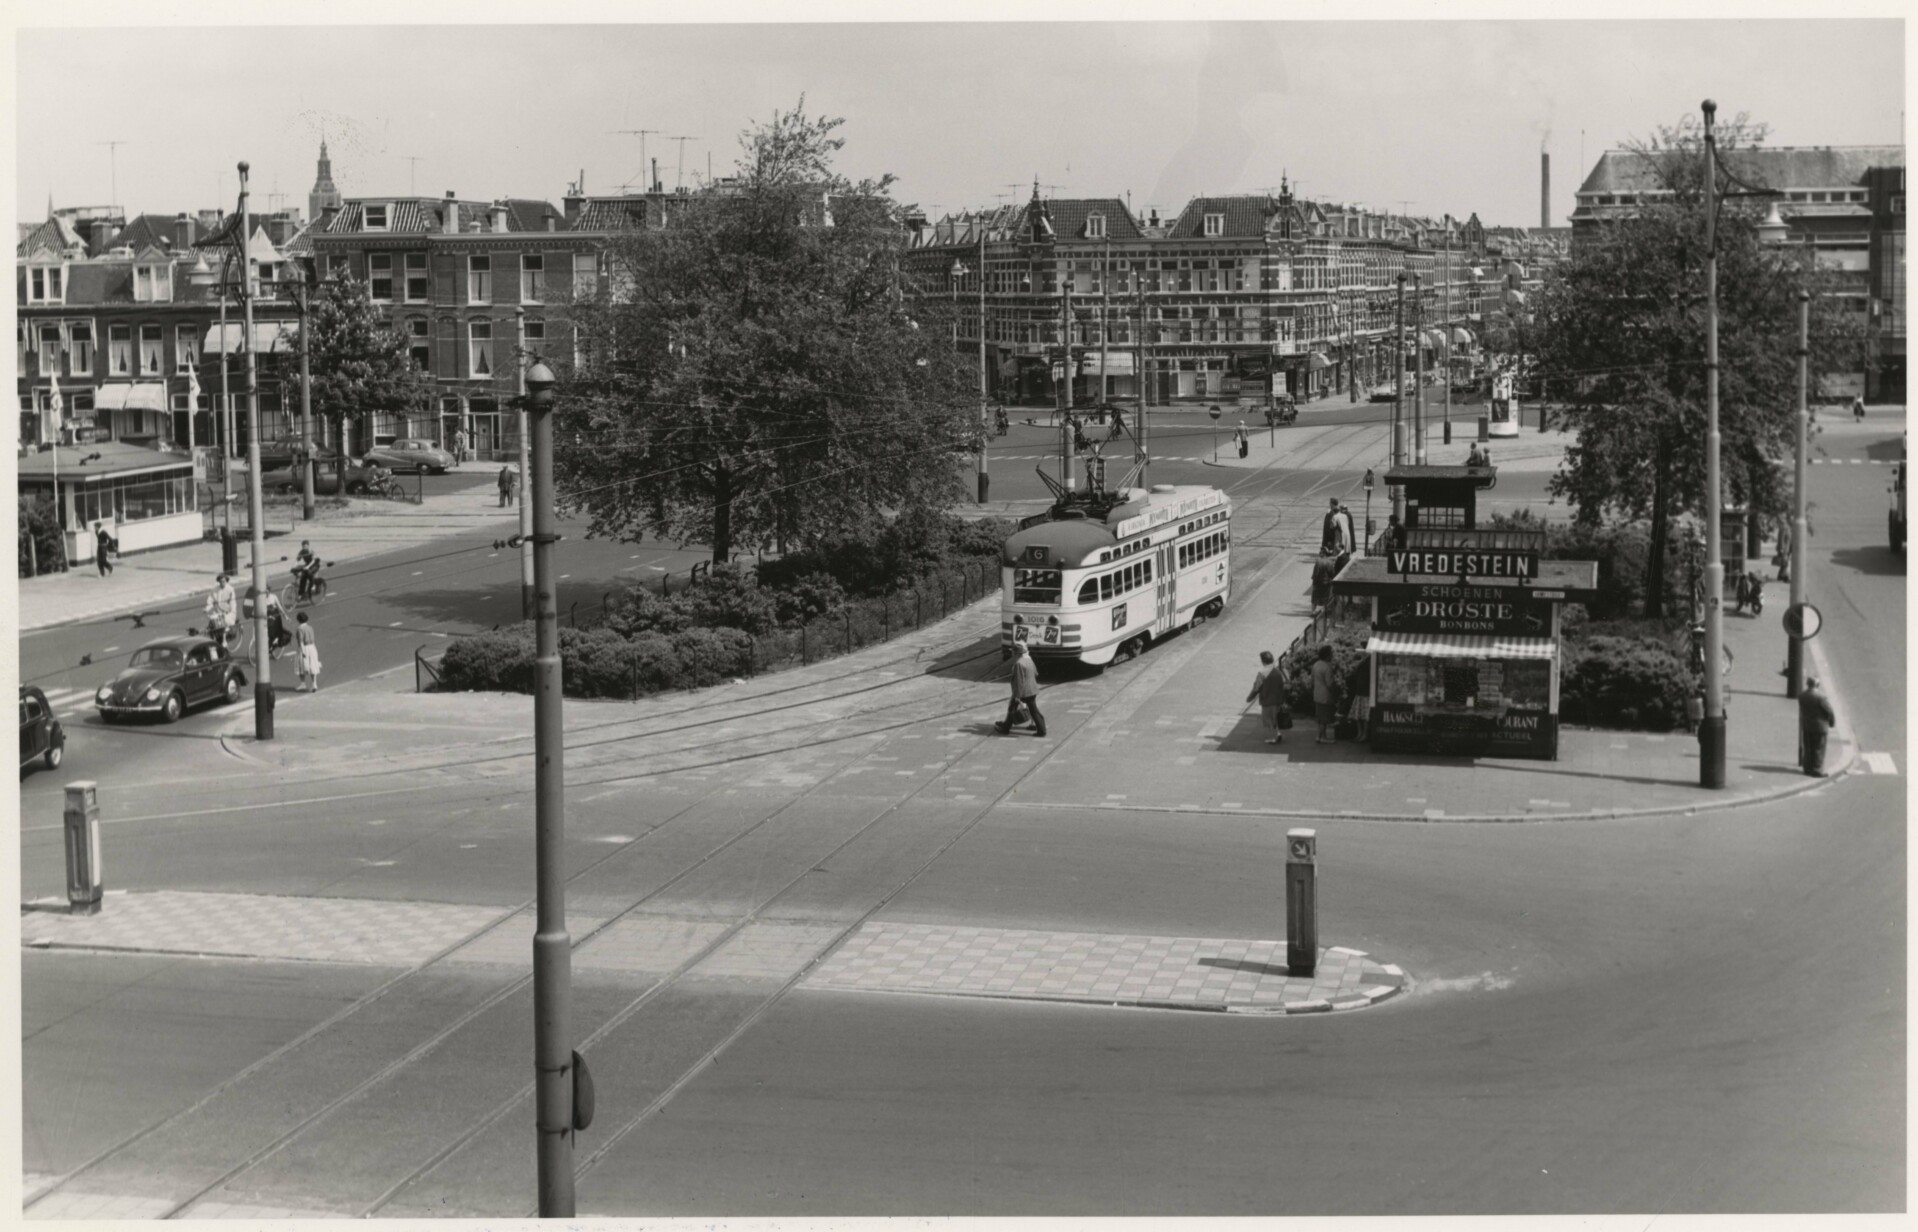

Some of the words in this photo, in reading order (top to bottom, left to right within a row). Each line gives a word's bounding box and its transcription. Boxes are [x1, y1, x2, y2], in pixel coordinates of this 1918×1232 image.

[1034, 549, 1043, 560] 6
[1393, 552, 1529, 576] VREDESTEIN
[1421, 585, 1503, 599] SCHOENEN
[1415, 601, 1513, 620] DROSTE
[1440, 620, 1495, 631] BONBONS
